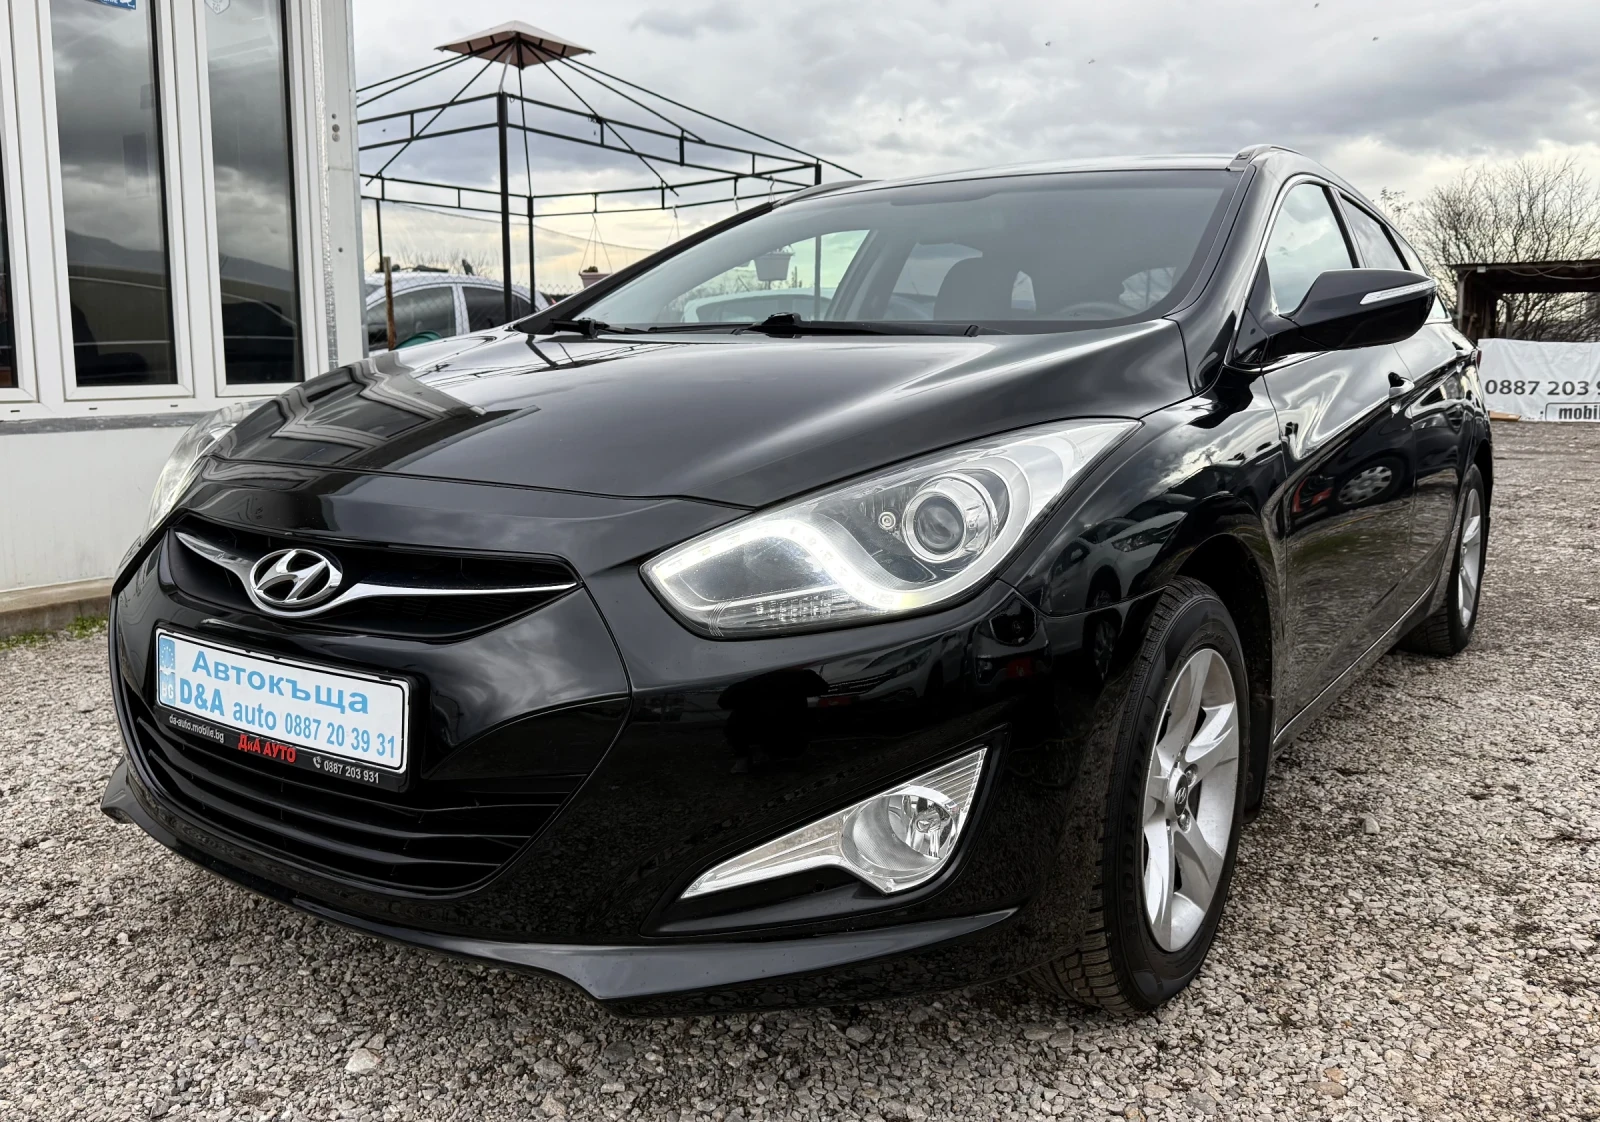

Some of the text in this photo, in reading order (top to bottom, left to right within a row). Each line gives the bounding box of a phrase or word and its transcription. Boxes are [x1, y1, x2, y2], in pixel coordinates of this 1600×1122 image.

[1485, 379, 1540, 395] 0887
[1547, 381, 1589, 395] 203
[161, 682, 174, 699] BG
[192, 650, 369, 715] Автокъща
[169, 714, 225, 744] da-auto.mobile.bg
[179, 678, 395, 758] D&A auto 0887 20 39 31
[263, 741, 297, 763] АУТО
[345, 766, 361, 779] 203
[363, 770, 379, 784] 931
